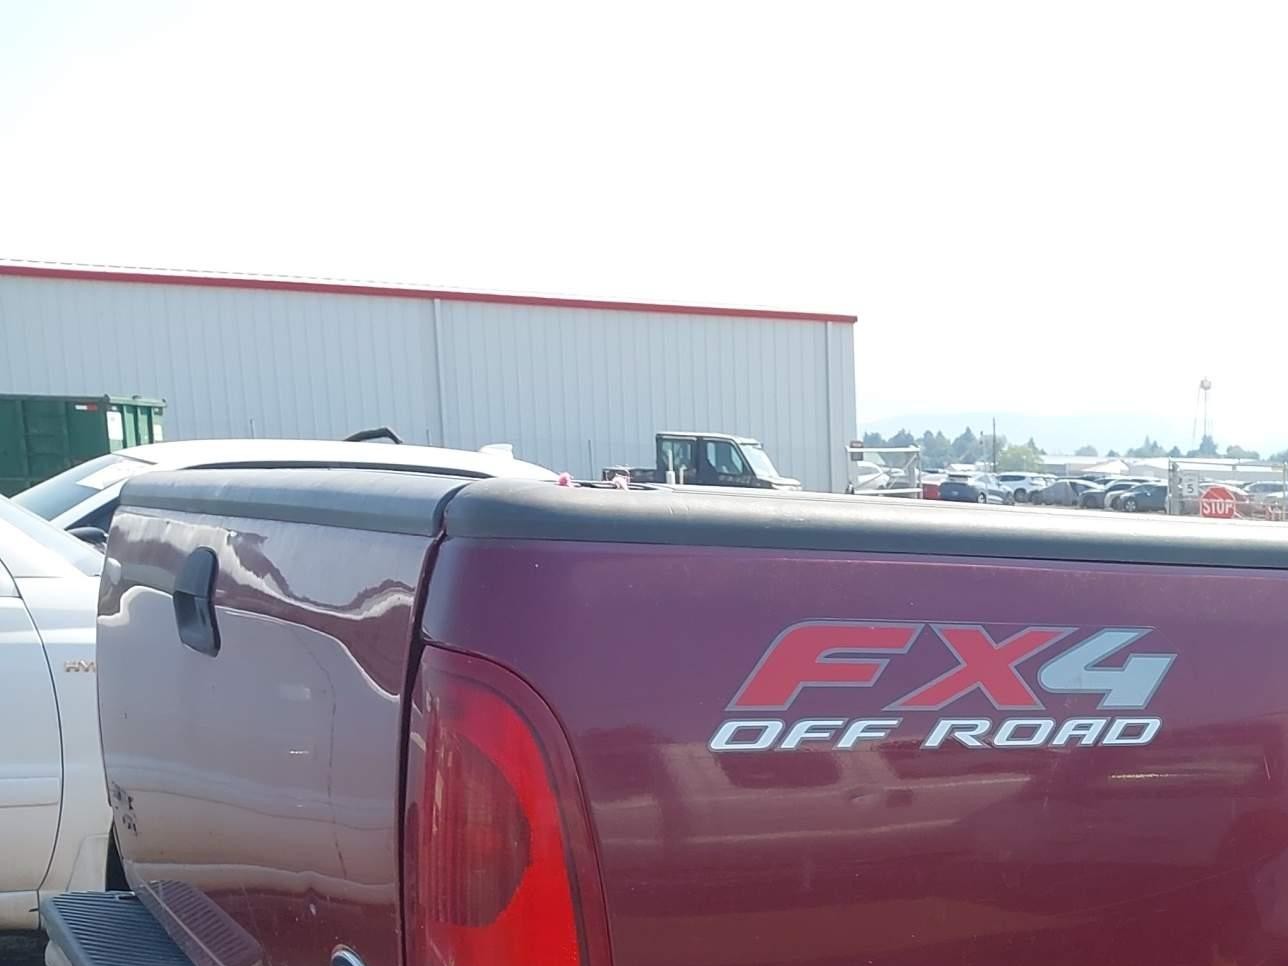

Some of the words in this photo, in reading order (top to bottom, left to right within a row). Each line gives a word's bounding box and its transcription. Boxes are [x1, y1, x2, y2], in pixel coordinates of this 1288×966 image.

[1203, 500, 1233, 514] STOP
[724, 619, 1178, 711] FX4
[708, 717, 903, 751] OFF
[920, 717, 1165, 749] ROAD
